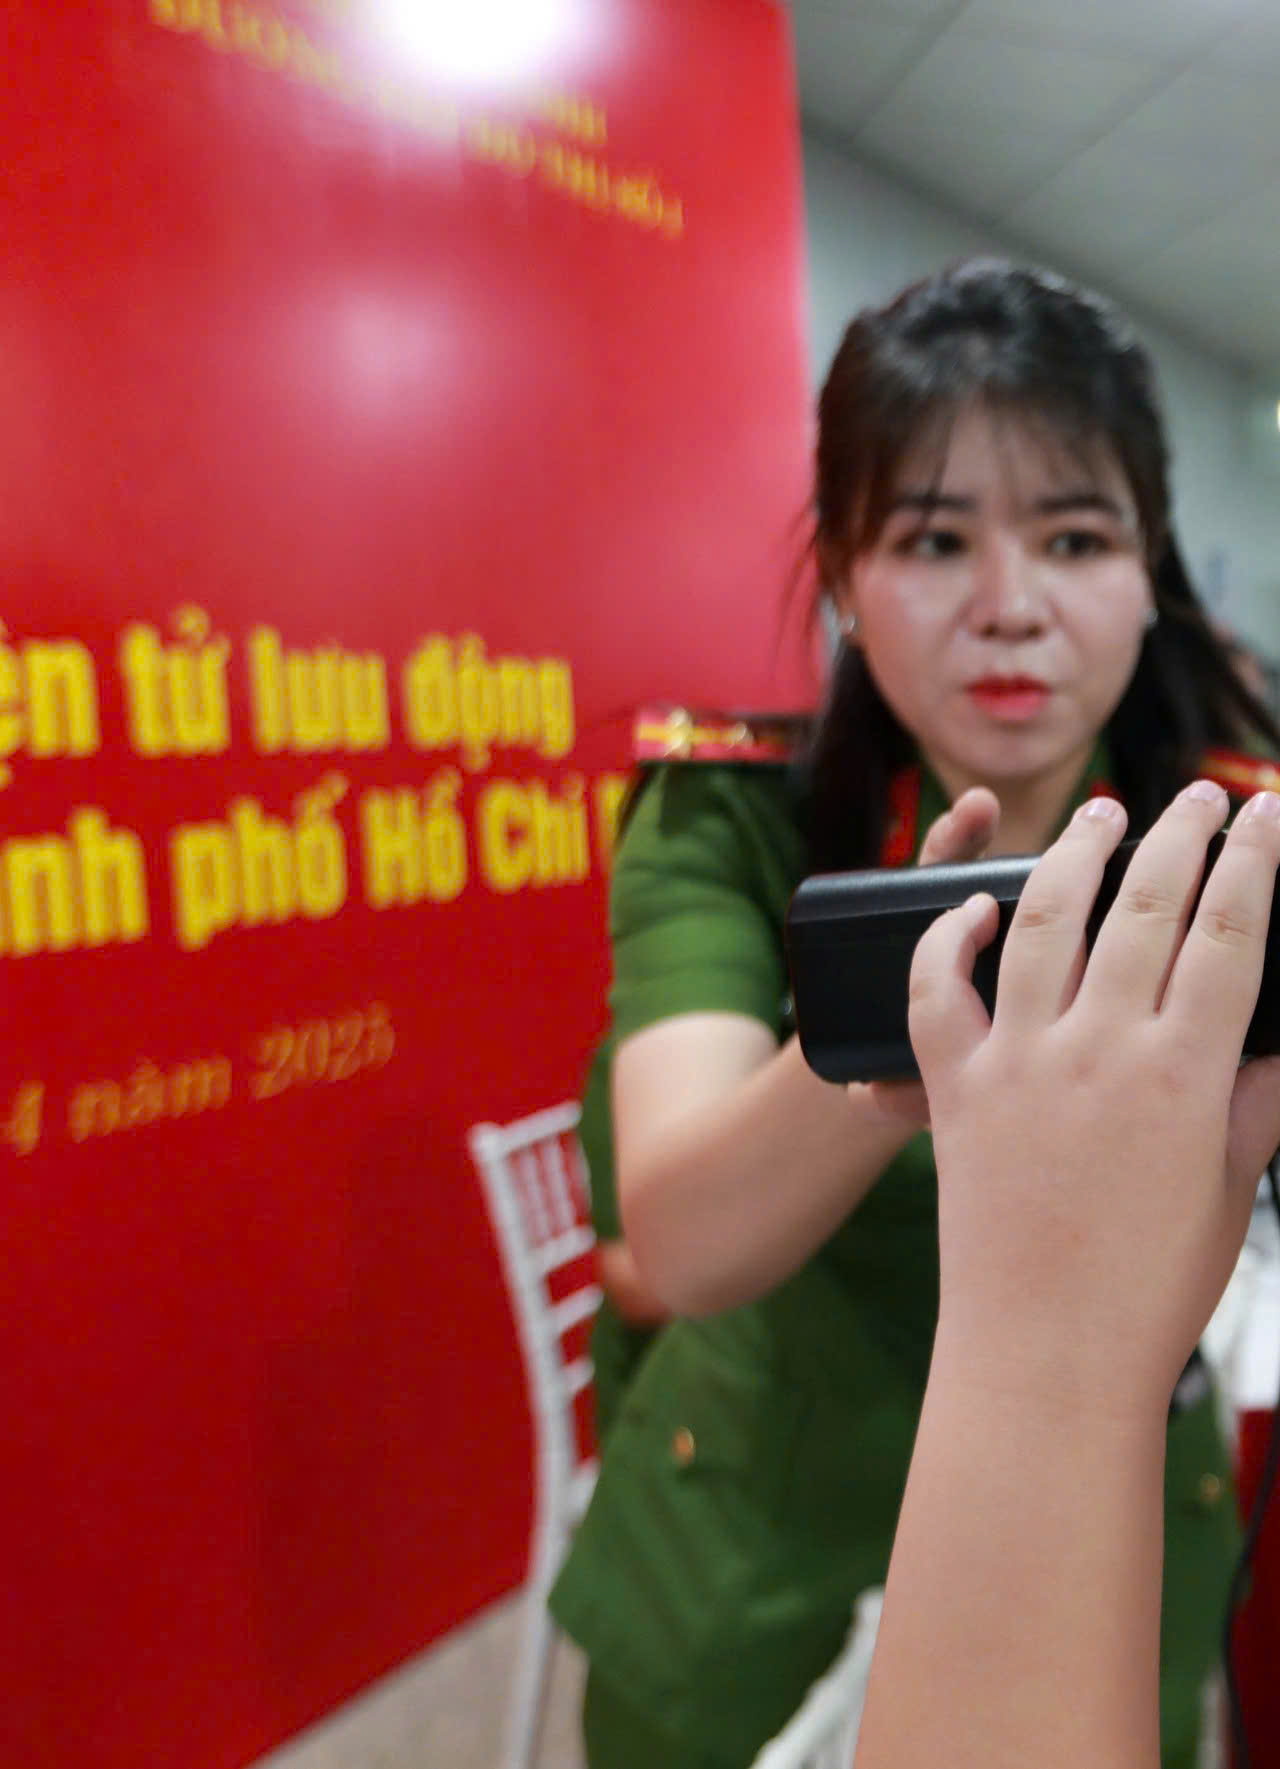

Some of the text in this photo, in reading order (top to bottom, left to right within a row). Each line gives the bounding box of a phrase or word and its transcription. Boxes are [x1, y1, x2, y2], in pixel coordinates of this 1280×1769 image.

[122, 606, 227, 755] tử
[251, 626, 388, 752] lưu
[406, 636, 571, 770] động
[0, 807, 147, 956] nh
[175, 772, 347, 948] phố
[481, 776, 588, 890] Chí
